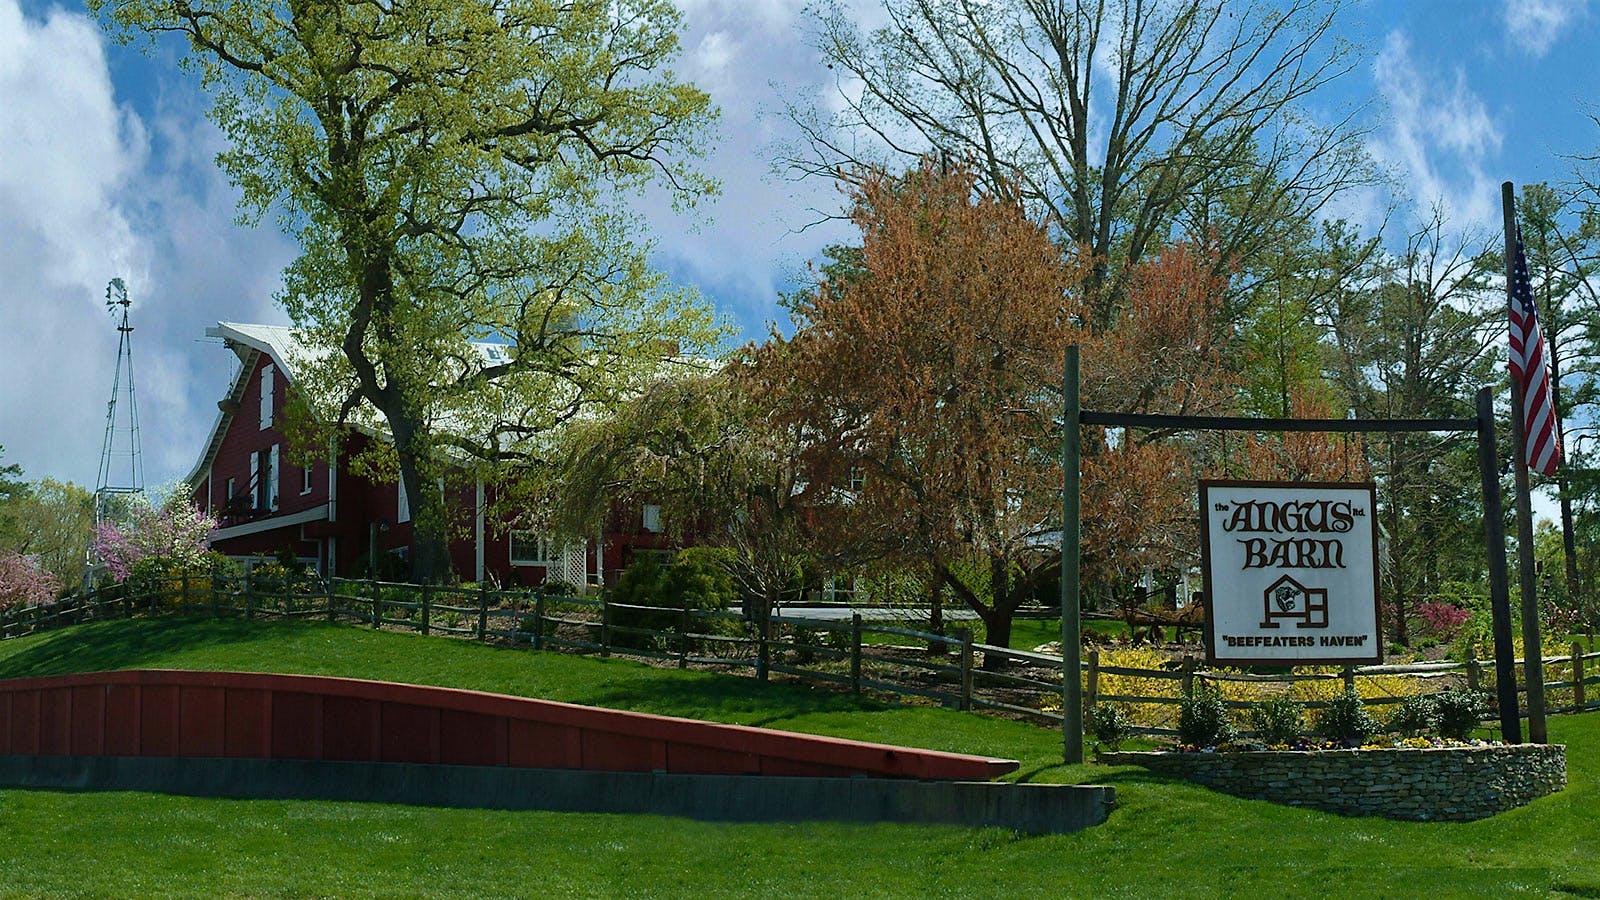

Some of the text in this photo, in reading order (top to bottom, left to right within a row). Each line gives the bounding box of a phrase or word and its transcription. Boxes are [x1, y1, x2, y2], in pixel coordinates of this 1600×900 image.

[1214, 502, 1229, 512] the
[1222, 499, 1354, 534] ANGUS
[1236, 537, 1346, 570] BARN
[1222, 635, 1368, 648] "BEEFEATERS HAVEN"
